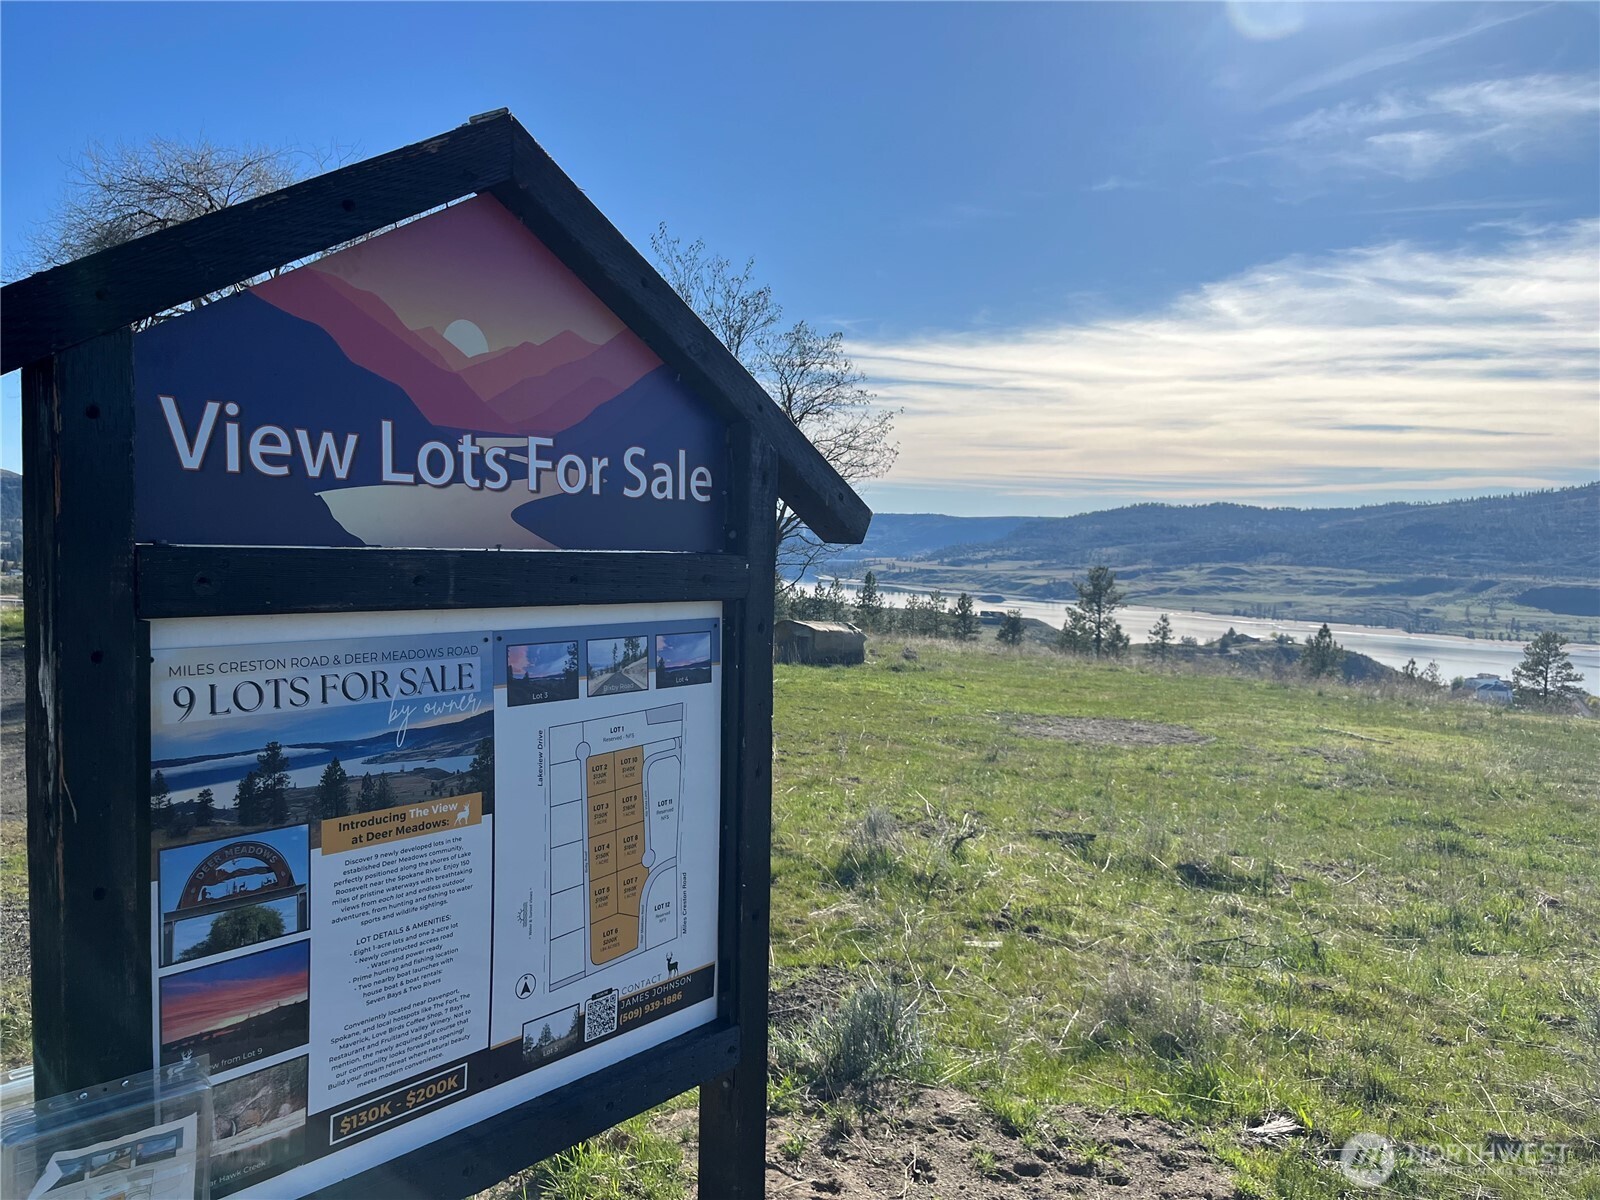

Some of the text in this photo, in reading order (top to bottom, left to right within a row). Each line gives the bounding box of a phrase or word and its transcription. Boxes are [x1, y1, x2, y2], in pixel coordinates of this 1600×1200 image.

[160, 394, 713, 502] View Lots For Sale
[169, 645, 479, 677] MILES CRESTON ROAD & DEER MEADOWS ROAD
[173, 662, 475, 723] 9 LOTS FOR SALE
[603, 682, 634, 692] Bixby Road
[388, 684, 482, 748] by owner
[338, 802, 459, 832] Introducing The View
[351, 818, 450, 845] at Deer Meadows:
[195, 845, 278, 880] DEER MEADOWS
[333, 875, 364, 888] perfectly
[364, 866, 398, 881] positioned
[399, 863, 417, 872] along
[429, 856, 449, 865] shores
[457, 851, 471, 859] Lake
[342, 845, 463, 875] established Deer Meadows community,
[344, 855, 373, 866] Discover
[379, 849, 399, 858] newly
[399, 842, 432, 855] developed
[331, 868, 472, 906] miles of pristine waterways with breathtaking
[335, 883, 368, 895] Roosevelt
[369, 880, 384, 888] near
[397, 871, 424, 881] Spokane
[425, 866, 442, 874] River.
[443, 862, 459, 870] Enjoy
[595, 888, 606, 896] LOT
[623, 878, 634, 886] LOT
[353, 946, 371, 956] Eight
[372, 941, 391, 950] 1-acre
[392, 937, 404, 945] lots
[405, 933, 417, 941] and
[418, 930, 430, 938] one
[431, 925, 449, 934] 2-acre
[356, 935, 372, 946] LOT
[372, 926, 404, 941] DETAILS
[411, 914, 451, 930] AMENITIES:
[358, 931, 453, 963] Newly constructed access road
[370, 943, 443, 968] Water and power ready
[621, 974, 662, 995] CONTACT
[621, 975, 692, 1009] JAMES JOHNSON
[330, 1030, 361, 1044] Spokane,
[362, 1024, 375, 1033] and
[376, 1018, 391, 1029] local
[392, 1010, 420, 1023] hotspots
[445, 997, 458, 1005] Fort,
[343, 988, 460, 1031] Conveniently located near Davenport,
[619, 991, 682, 1025] (509) 939-1886
[339, 1036, 370, 1050] Maverick,
[371, 1030, 387, 1039] Love
[388, 1023, 405, 1033] Birds
[405, 1017, 425, 1027] Coffee
[426, 1011, 443, 1020] Shop,
[449, 1003, 463, 1012] Bays
[221, 1056, 240, 1066] from
[243, 1050, 256, 1060] Lot
[257, 1047, 263, 1055] 9
[356, 1052, 443, 1088] meets modern convenience.
[339, 1101, 392, 1135] $130K
[405, 1075, 459, 1109] $200K
[219, 1170, 242, 1183] Hawk
[243, 1159, 267, 1174] Creek
